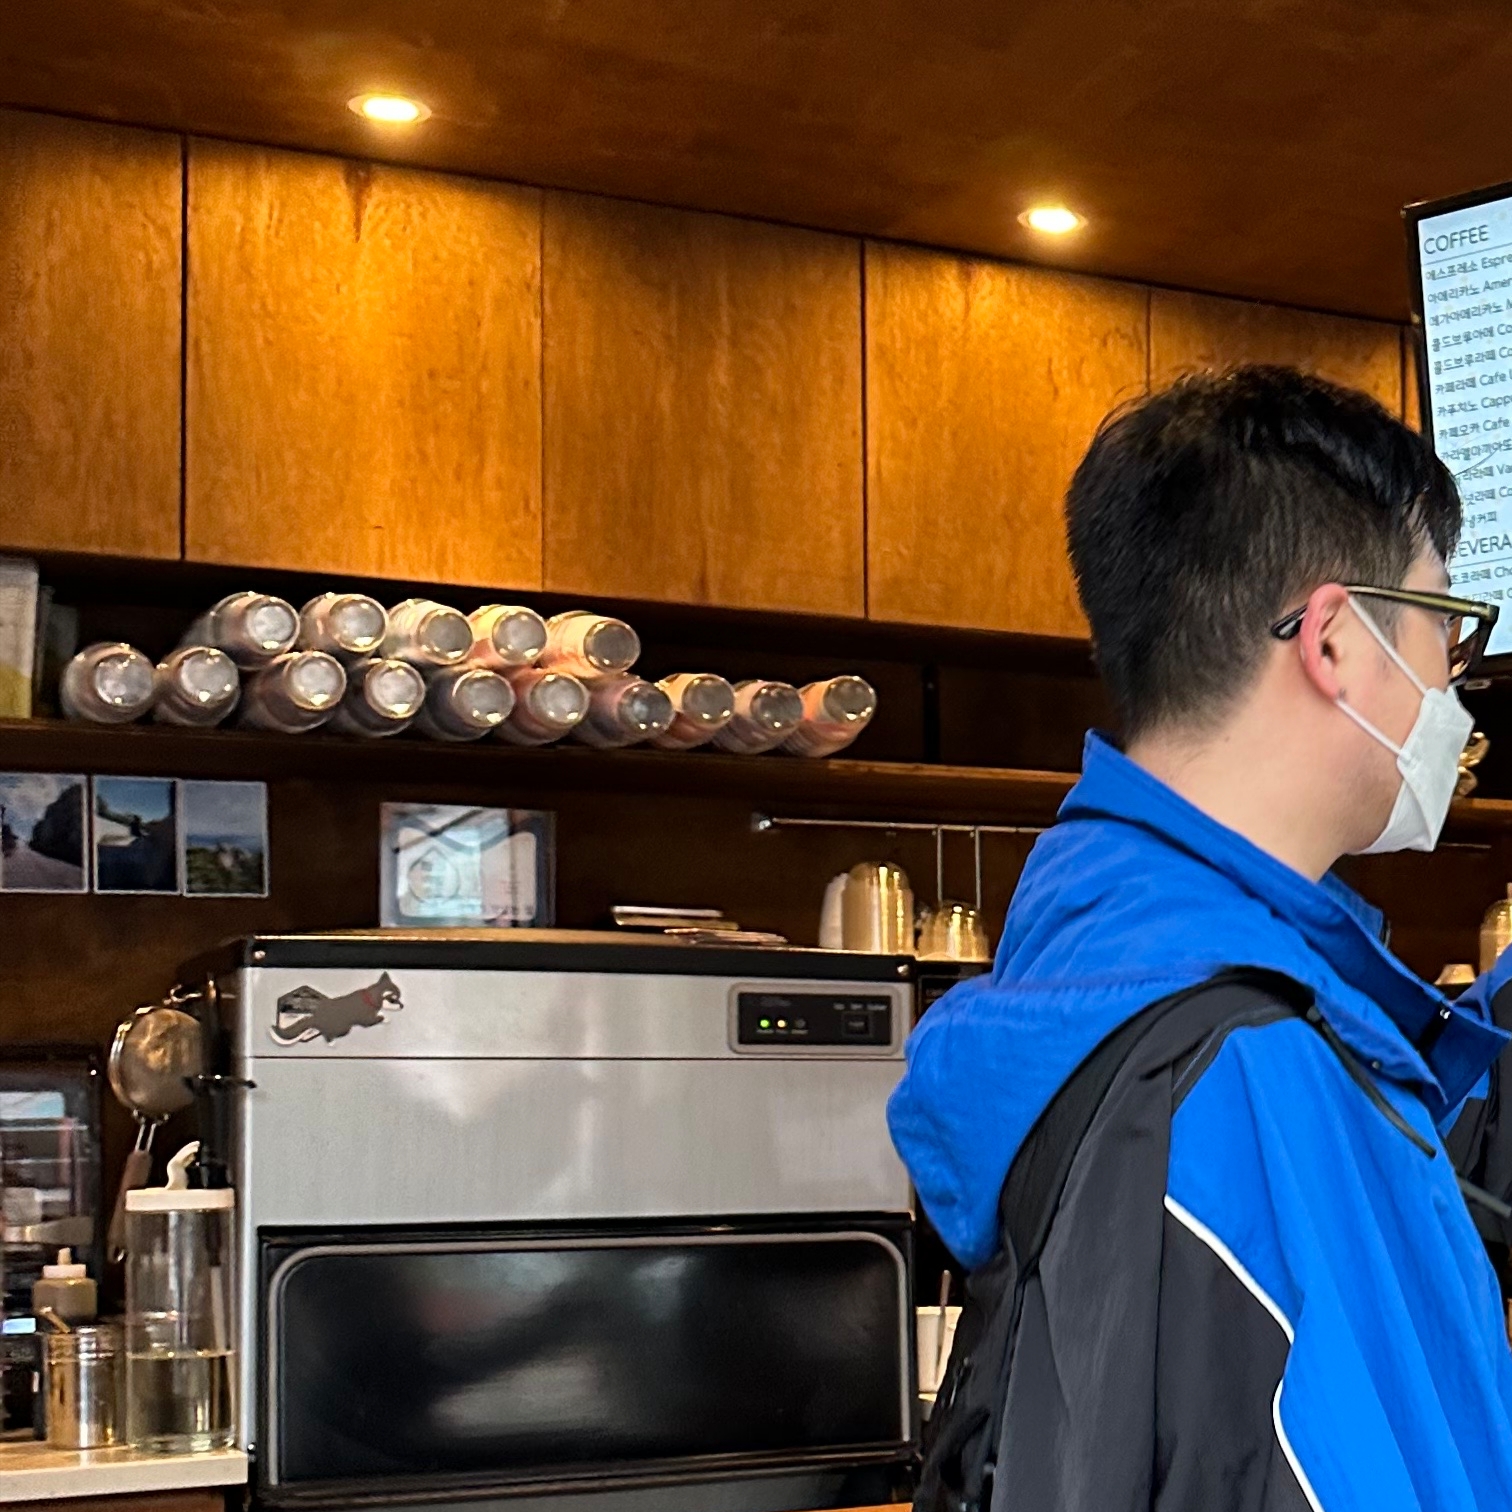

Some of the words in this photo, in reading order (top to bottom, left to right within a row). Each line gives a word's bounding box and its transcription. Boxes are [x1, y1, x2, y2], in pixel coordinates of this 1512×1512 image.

[1423, 224, 1489, 255] COFFEE
[1479, 369, 1507, 387] Cafe
[1482, 415, 1510, 432] Cafe
